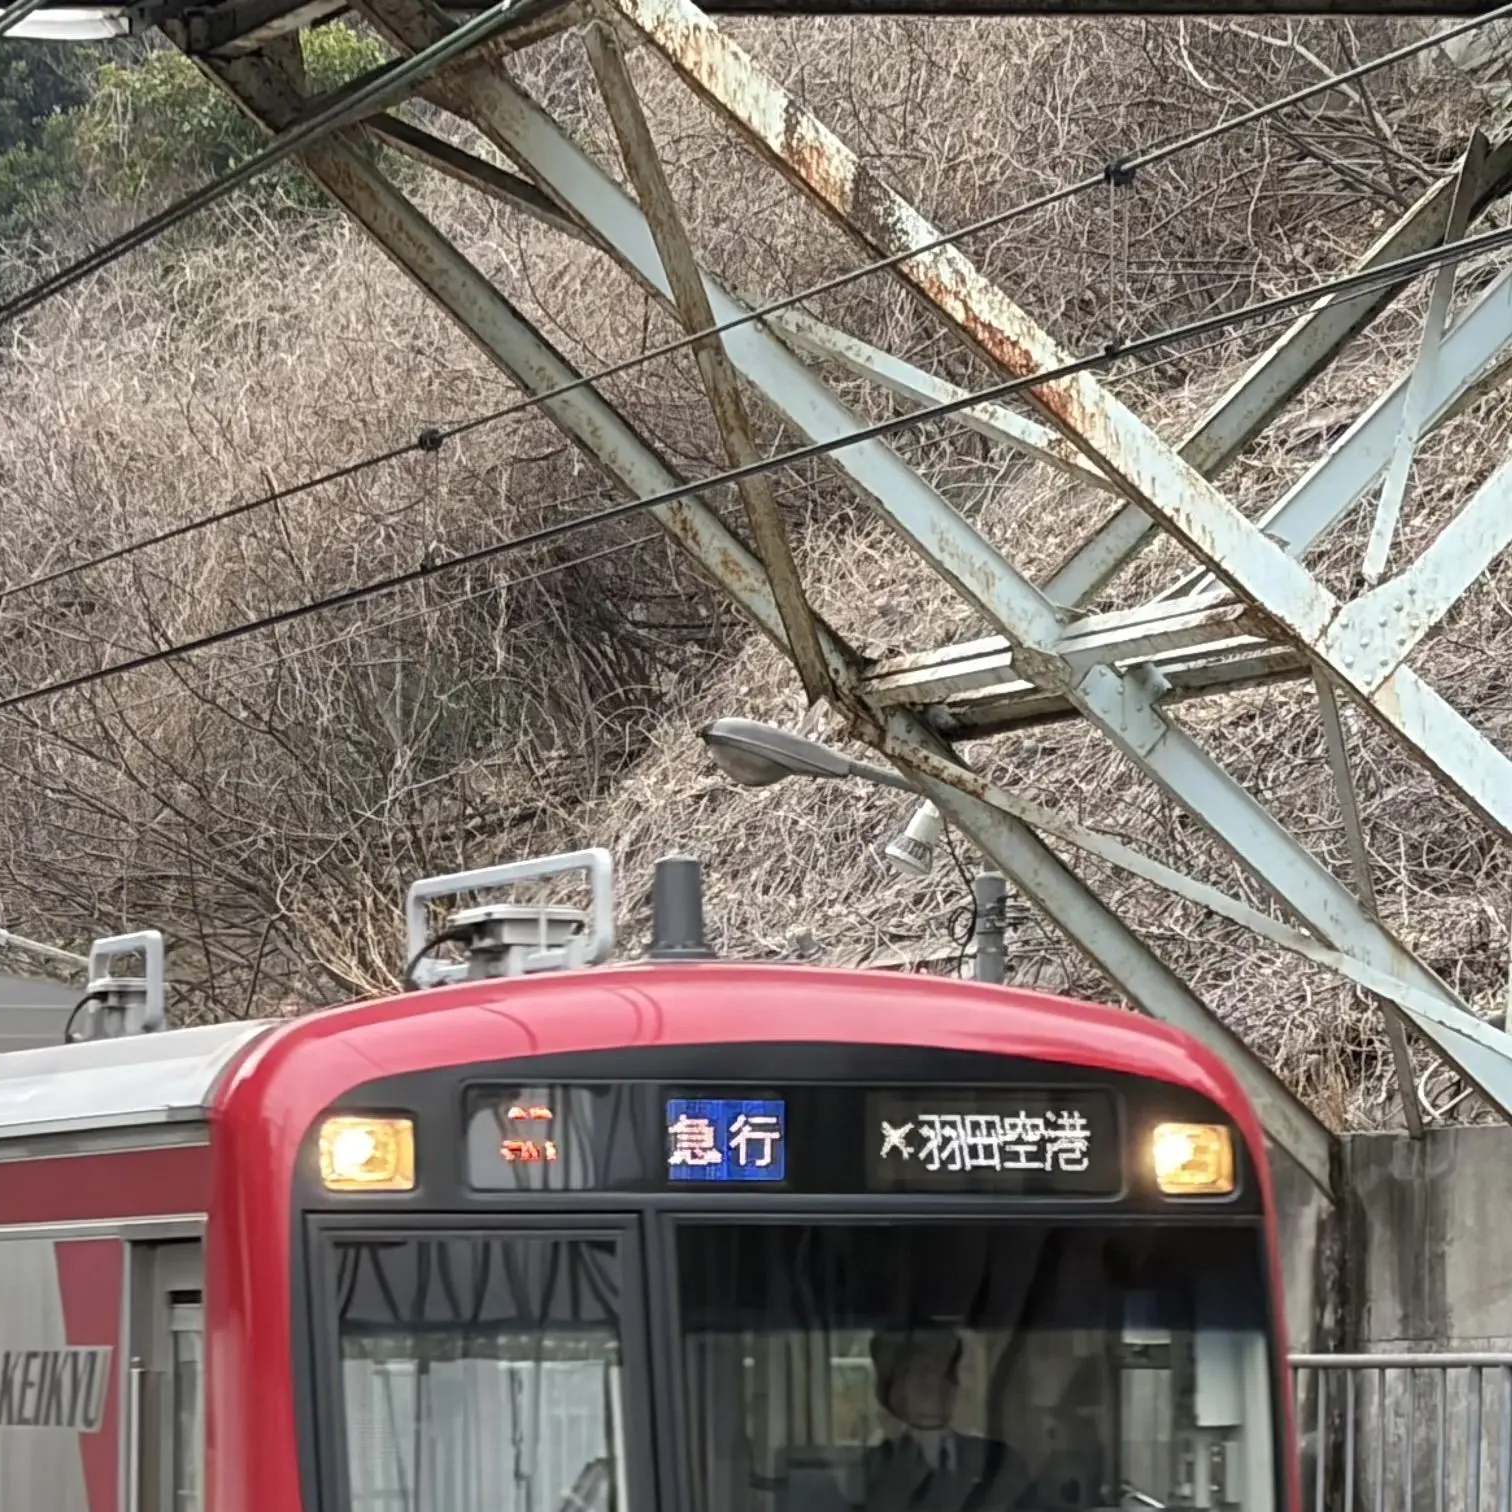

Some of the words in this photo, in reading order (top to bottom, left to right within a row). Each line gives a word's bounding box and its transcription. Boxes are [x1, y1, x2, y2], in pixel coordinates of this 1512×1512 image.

[667, 1113, 781, 1167] 急行
[917, 1110, 1091, 1172] 羽田空港
